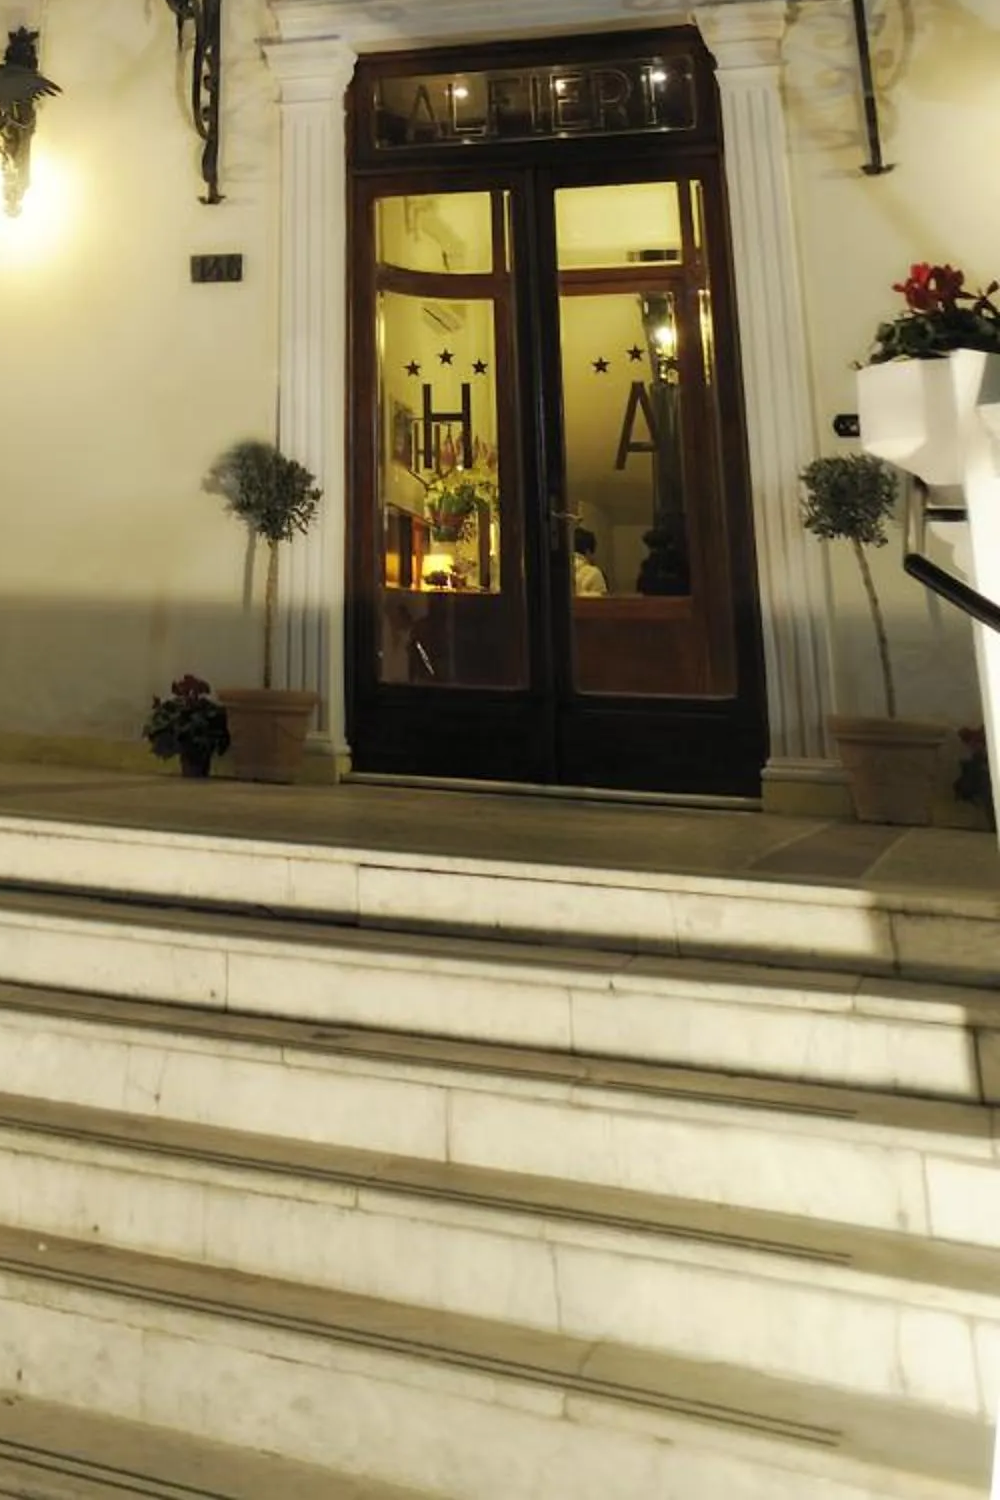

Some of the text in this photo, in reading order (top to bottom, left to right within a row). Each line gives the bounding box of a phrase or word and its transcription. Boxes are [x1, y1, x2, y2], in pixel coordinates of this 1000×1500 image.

[408, 66, 659, 140] ALFIERI
[422, 381, 661, 470] H A
